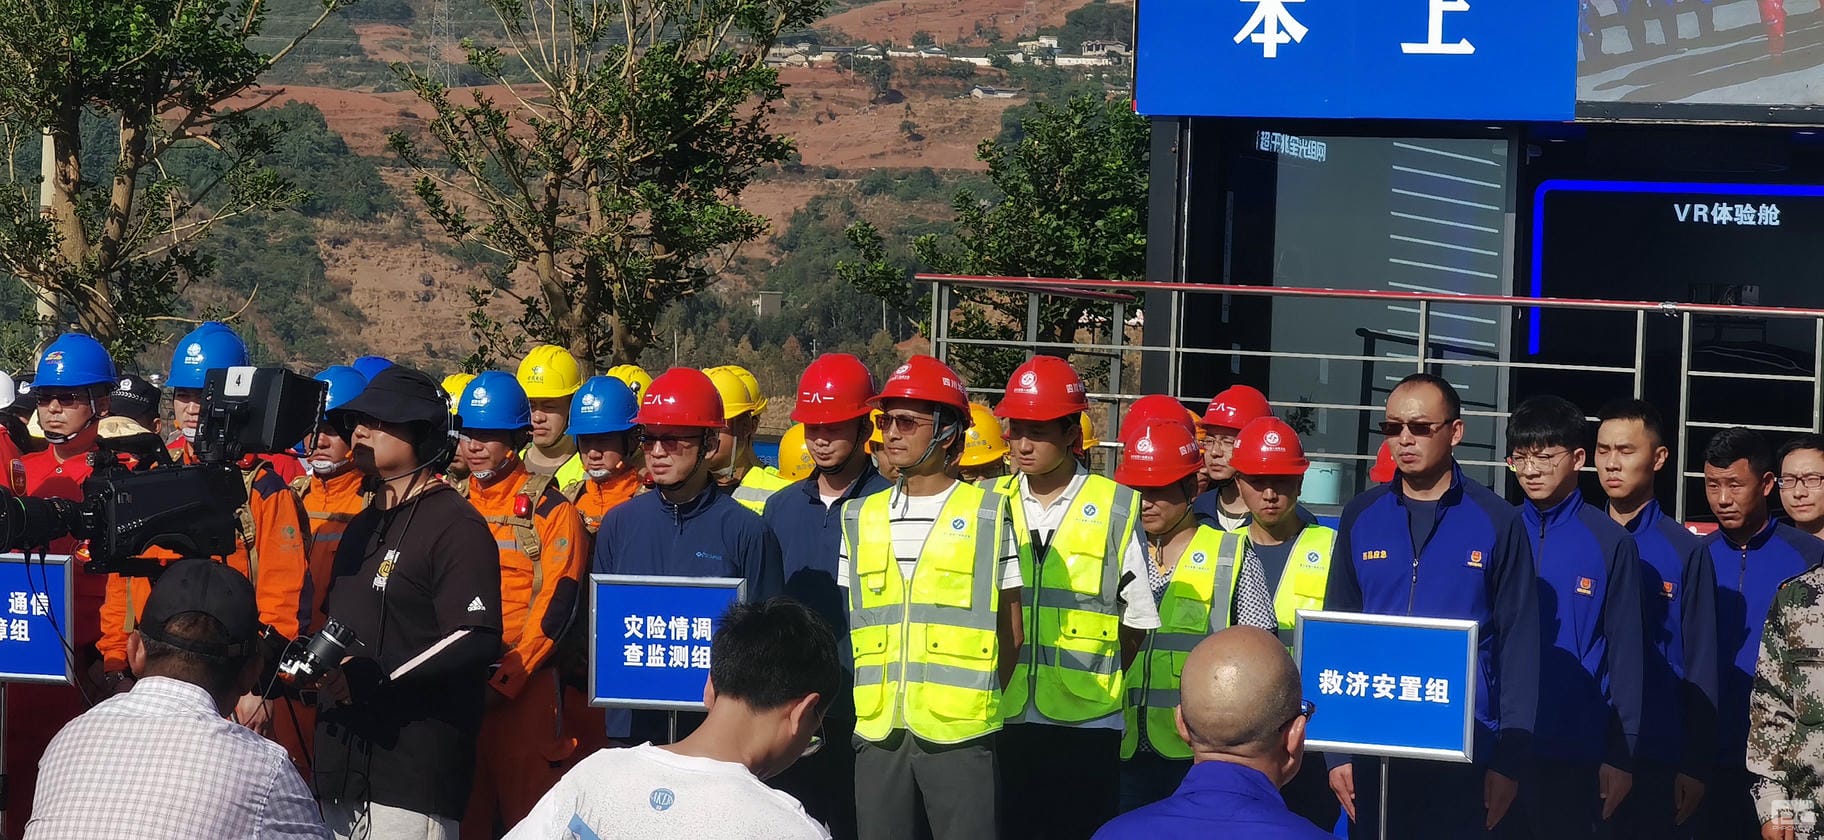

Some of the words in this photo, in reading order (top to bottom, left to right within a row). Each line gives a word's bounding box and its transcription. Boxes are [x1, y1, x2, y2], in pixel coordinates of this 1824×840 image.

[1400, 0, 1476, 54] 上
[1673, 202, 1780, 226] VR体验舱
[235, 374, 242, 387] 4
[643, 393, 676, 405] 二八一
[802, 391, 834, 403] 二八一
[1209, 402, 1237, 411] 二八一
[8, 591, 49, 616] 通信
[623, 614, 713, 642] 灾险情调
[623, 642, 712, 669] 查监测组
[1318, 668, 1450, 704] 救济安置组
